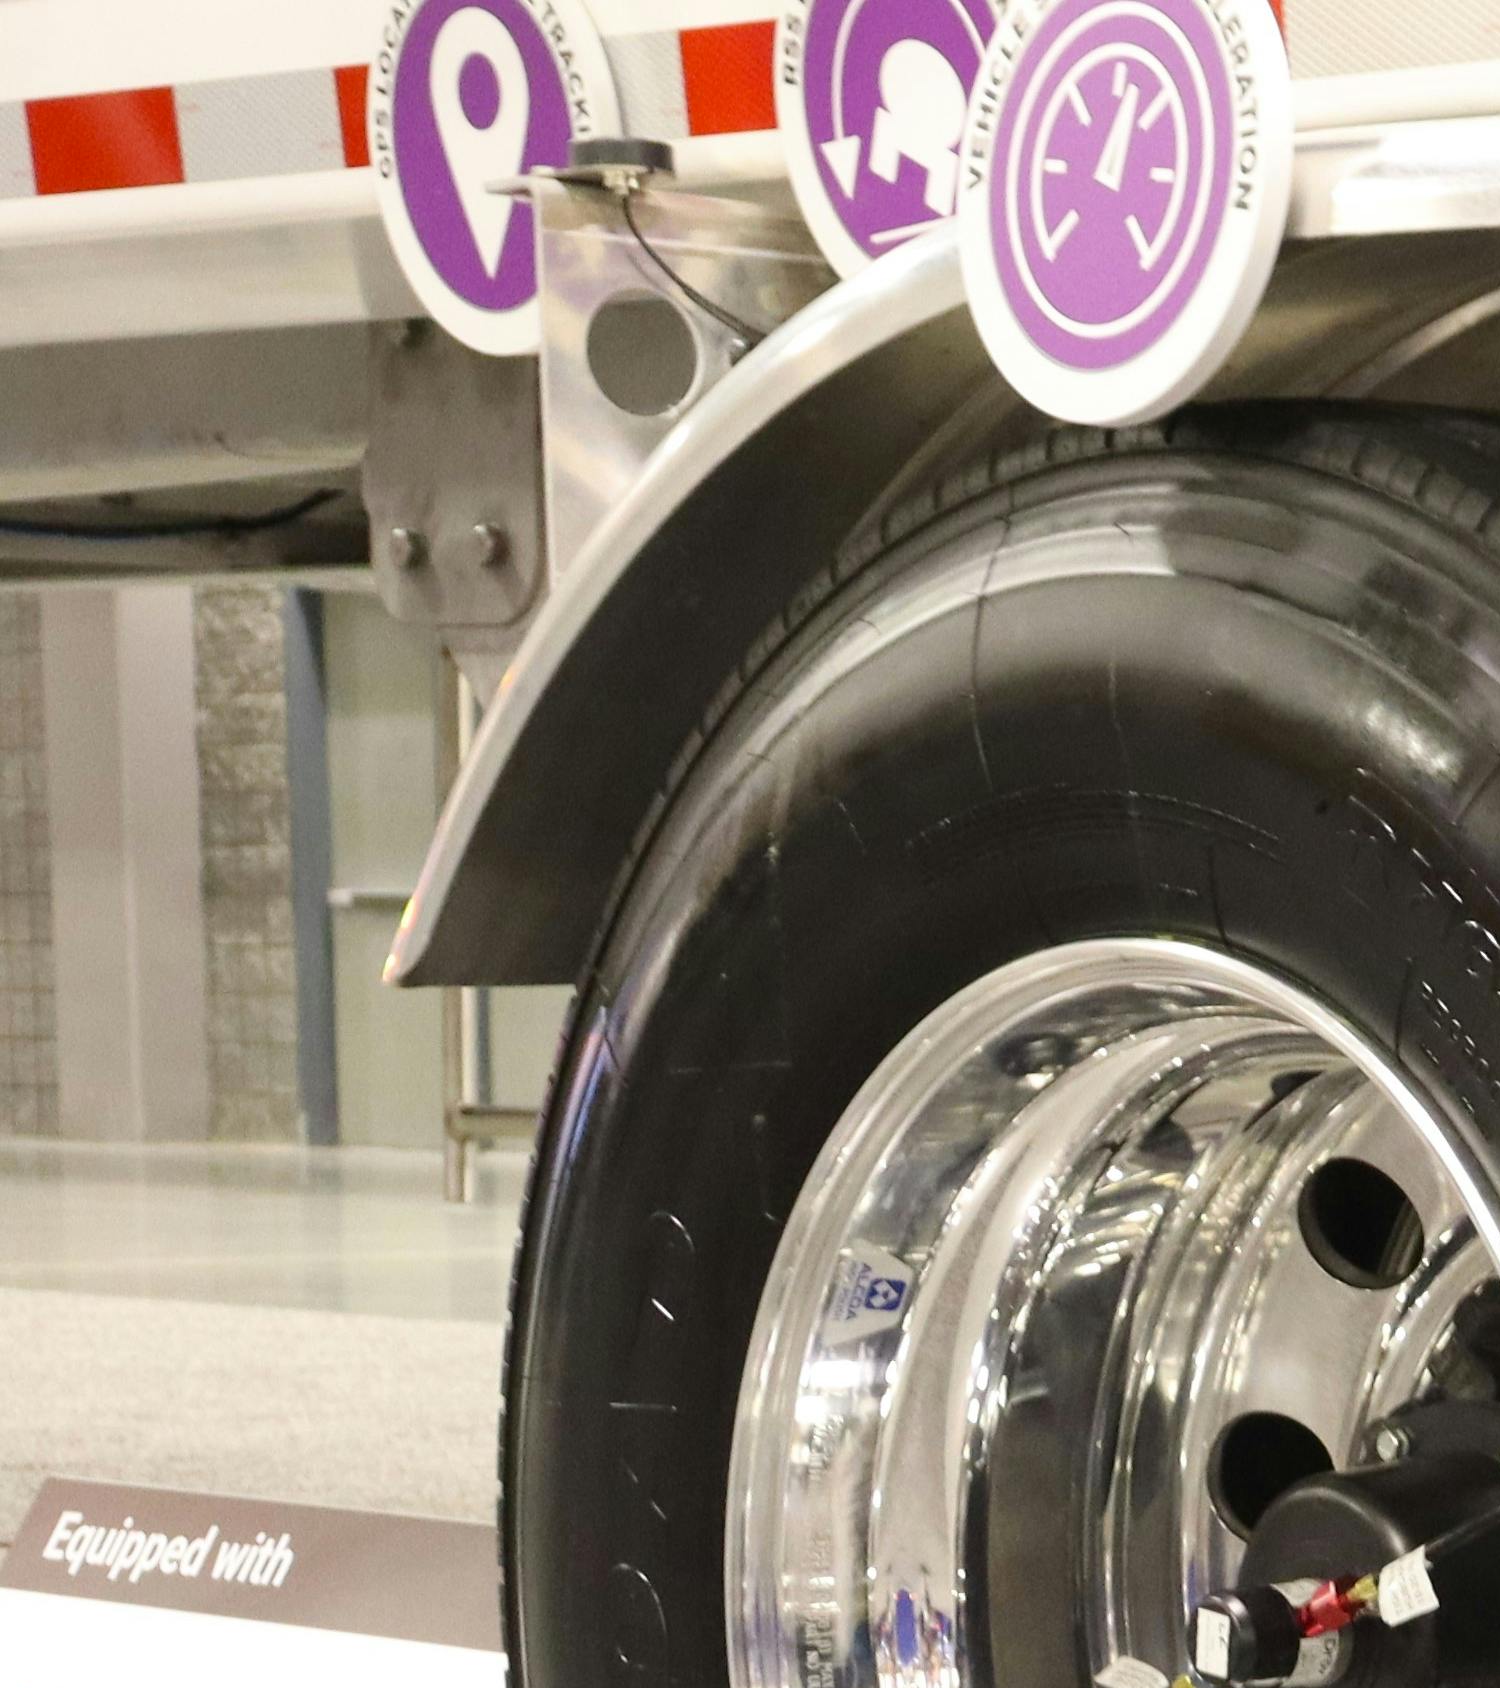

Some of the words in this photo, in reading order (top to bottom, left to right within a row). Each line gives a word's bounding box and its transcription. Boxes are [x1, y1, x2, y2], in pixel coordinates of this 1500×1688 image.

[967, 14, 1030, 190] VEHICLE
[375, 110, 392, 179] GPS
[43, 1510, 219, 1583] Equipped
[211, 1531, 294, 1587] with
